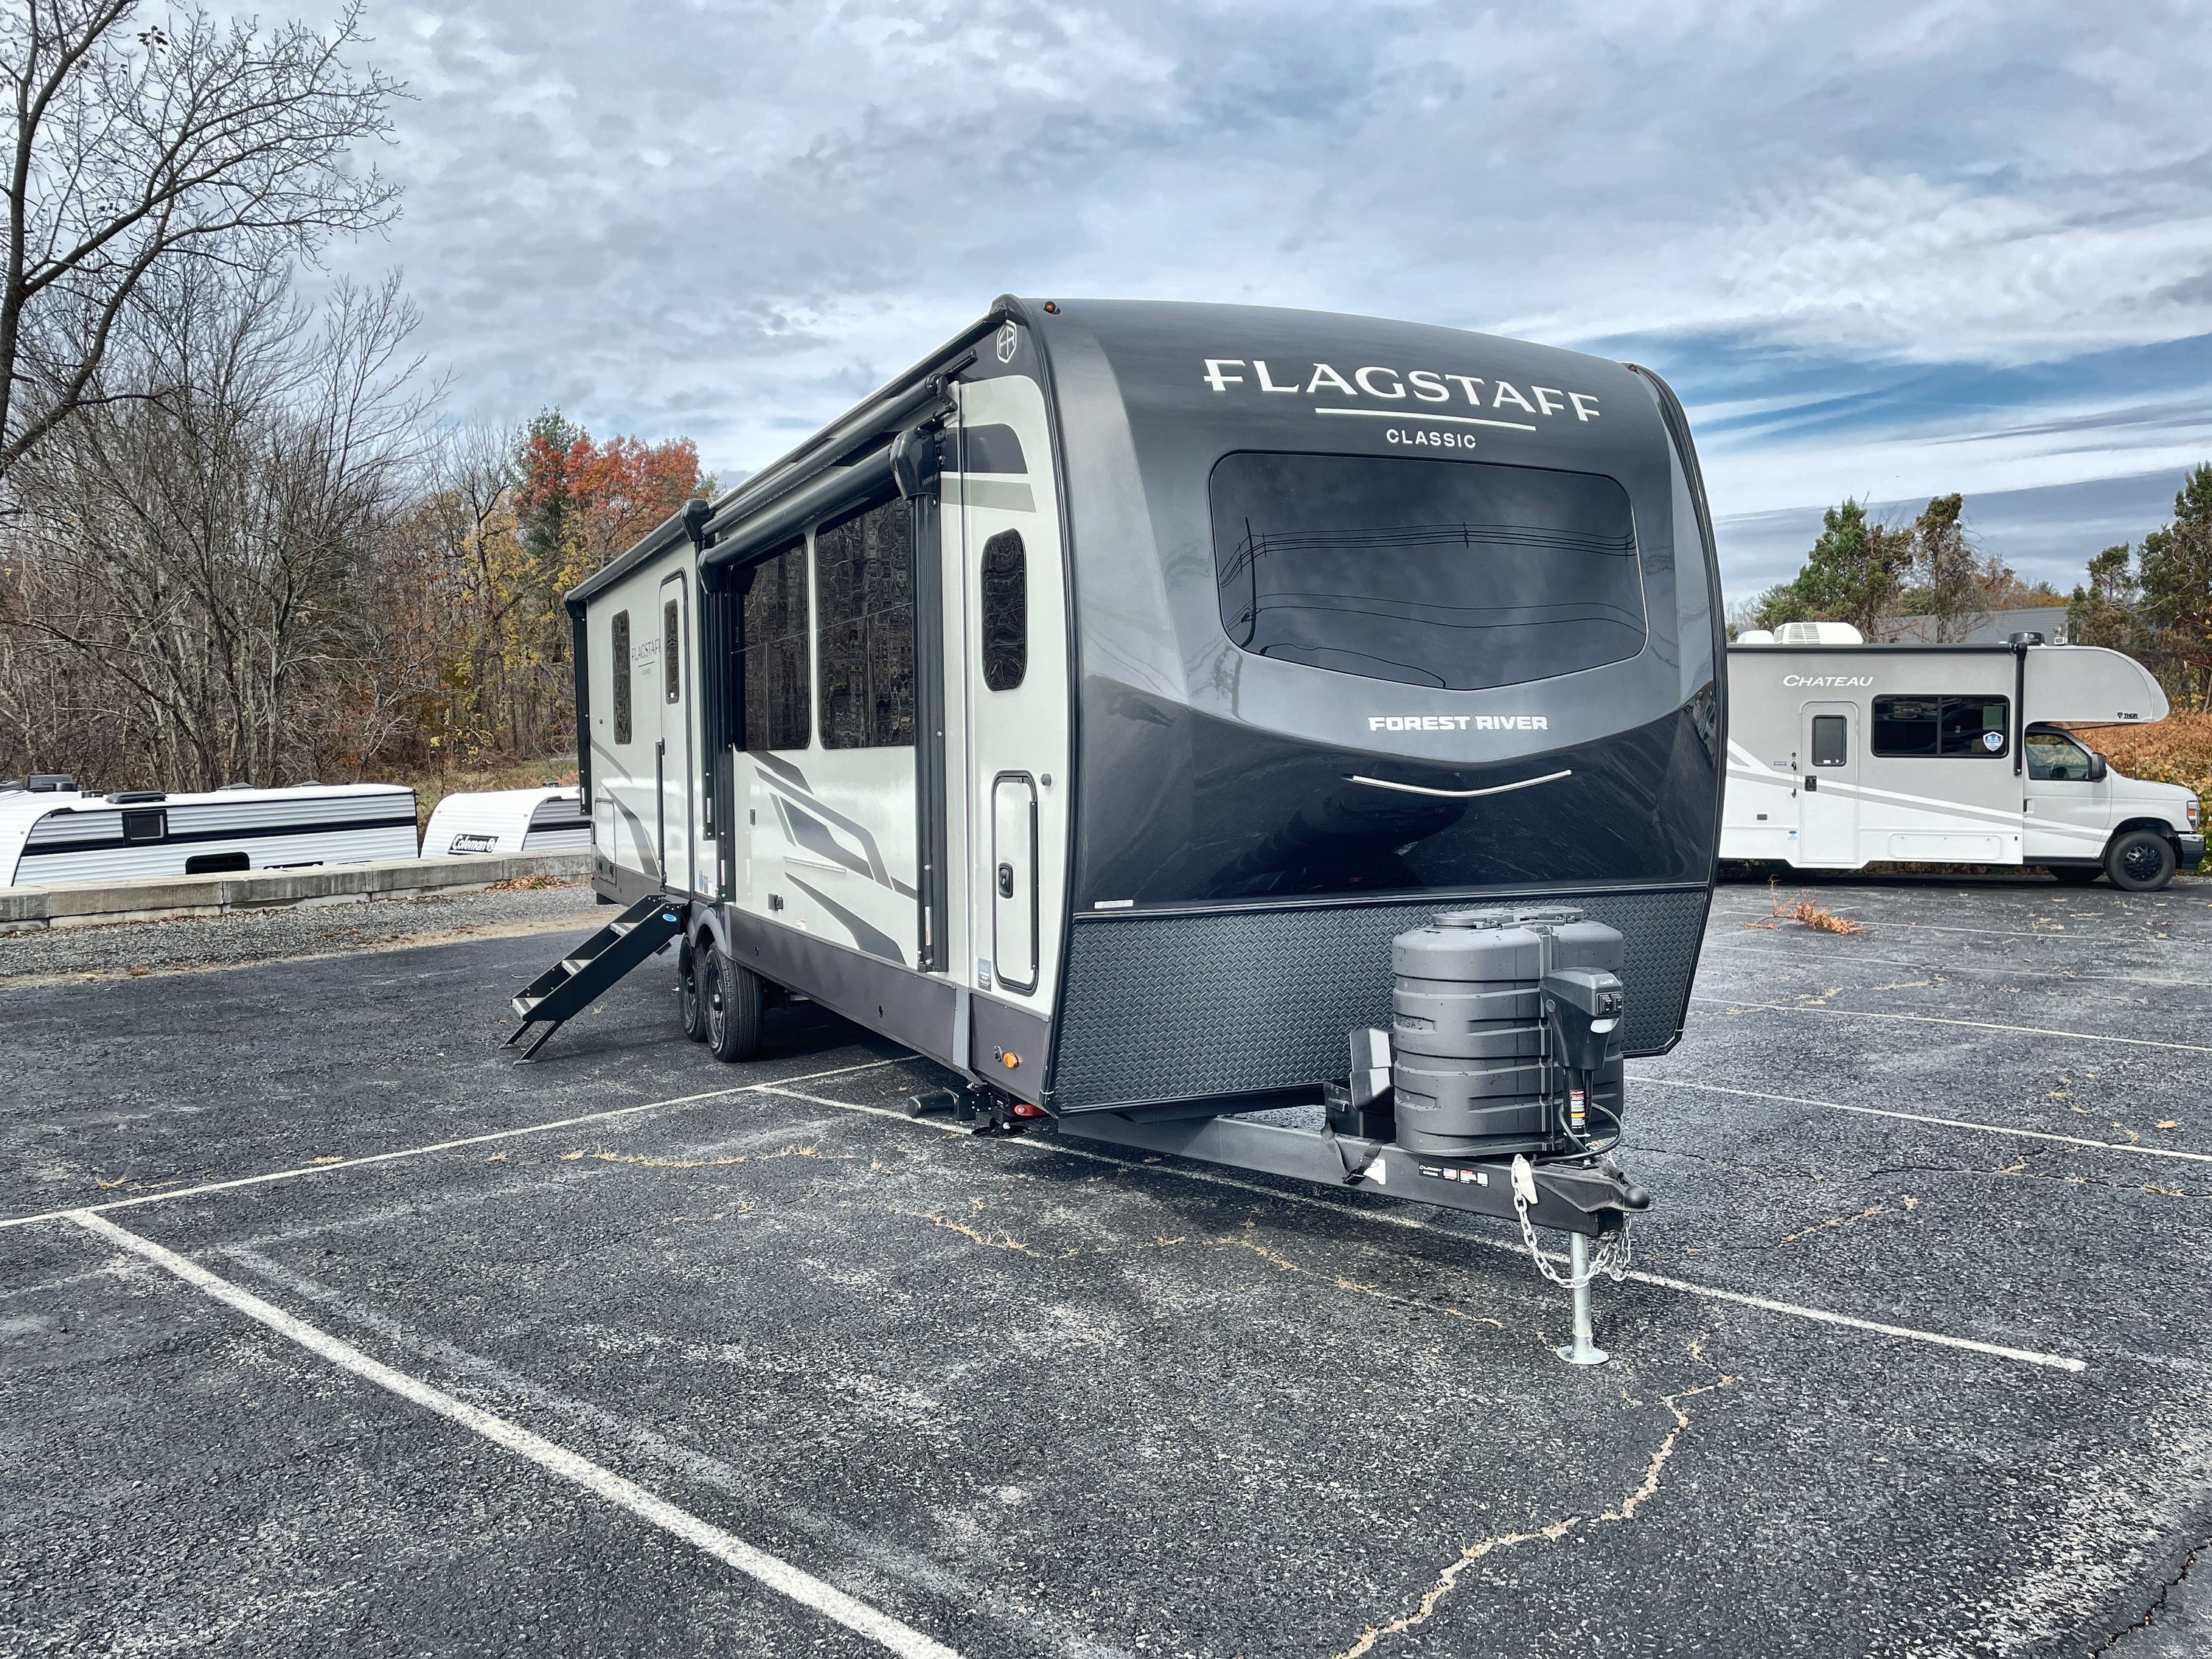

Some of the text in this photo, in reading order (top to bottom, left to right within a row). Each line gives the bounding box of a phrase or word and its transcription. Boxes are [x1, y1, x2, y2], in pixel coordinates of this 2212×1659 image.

[1203, 358, 1601, 422] FLAGSTAFF
[1386, 429, 1477, 449] CLASSIC
[1782, 675, 1874, 687] CHATEAU
[1367, 716, 1548, 731] FOREST RIVER
[452, 835, 487, 851] Coleman
[1404, 1018, 1423, 1030] GAS
